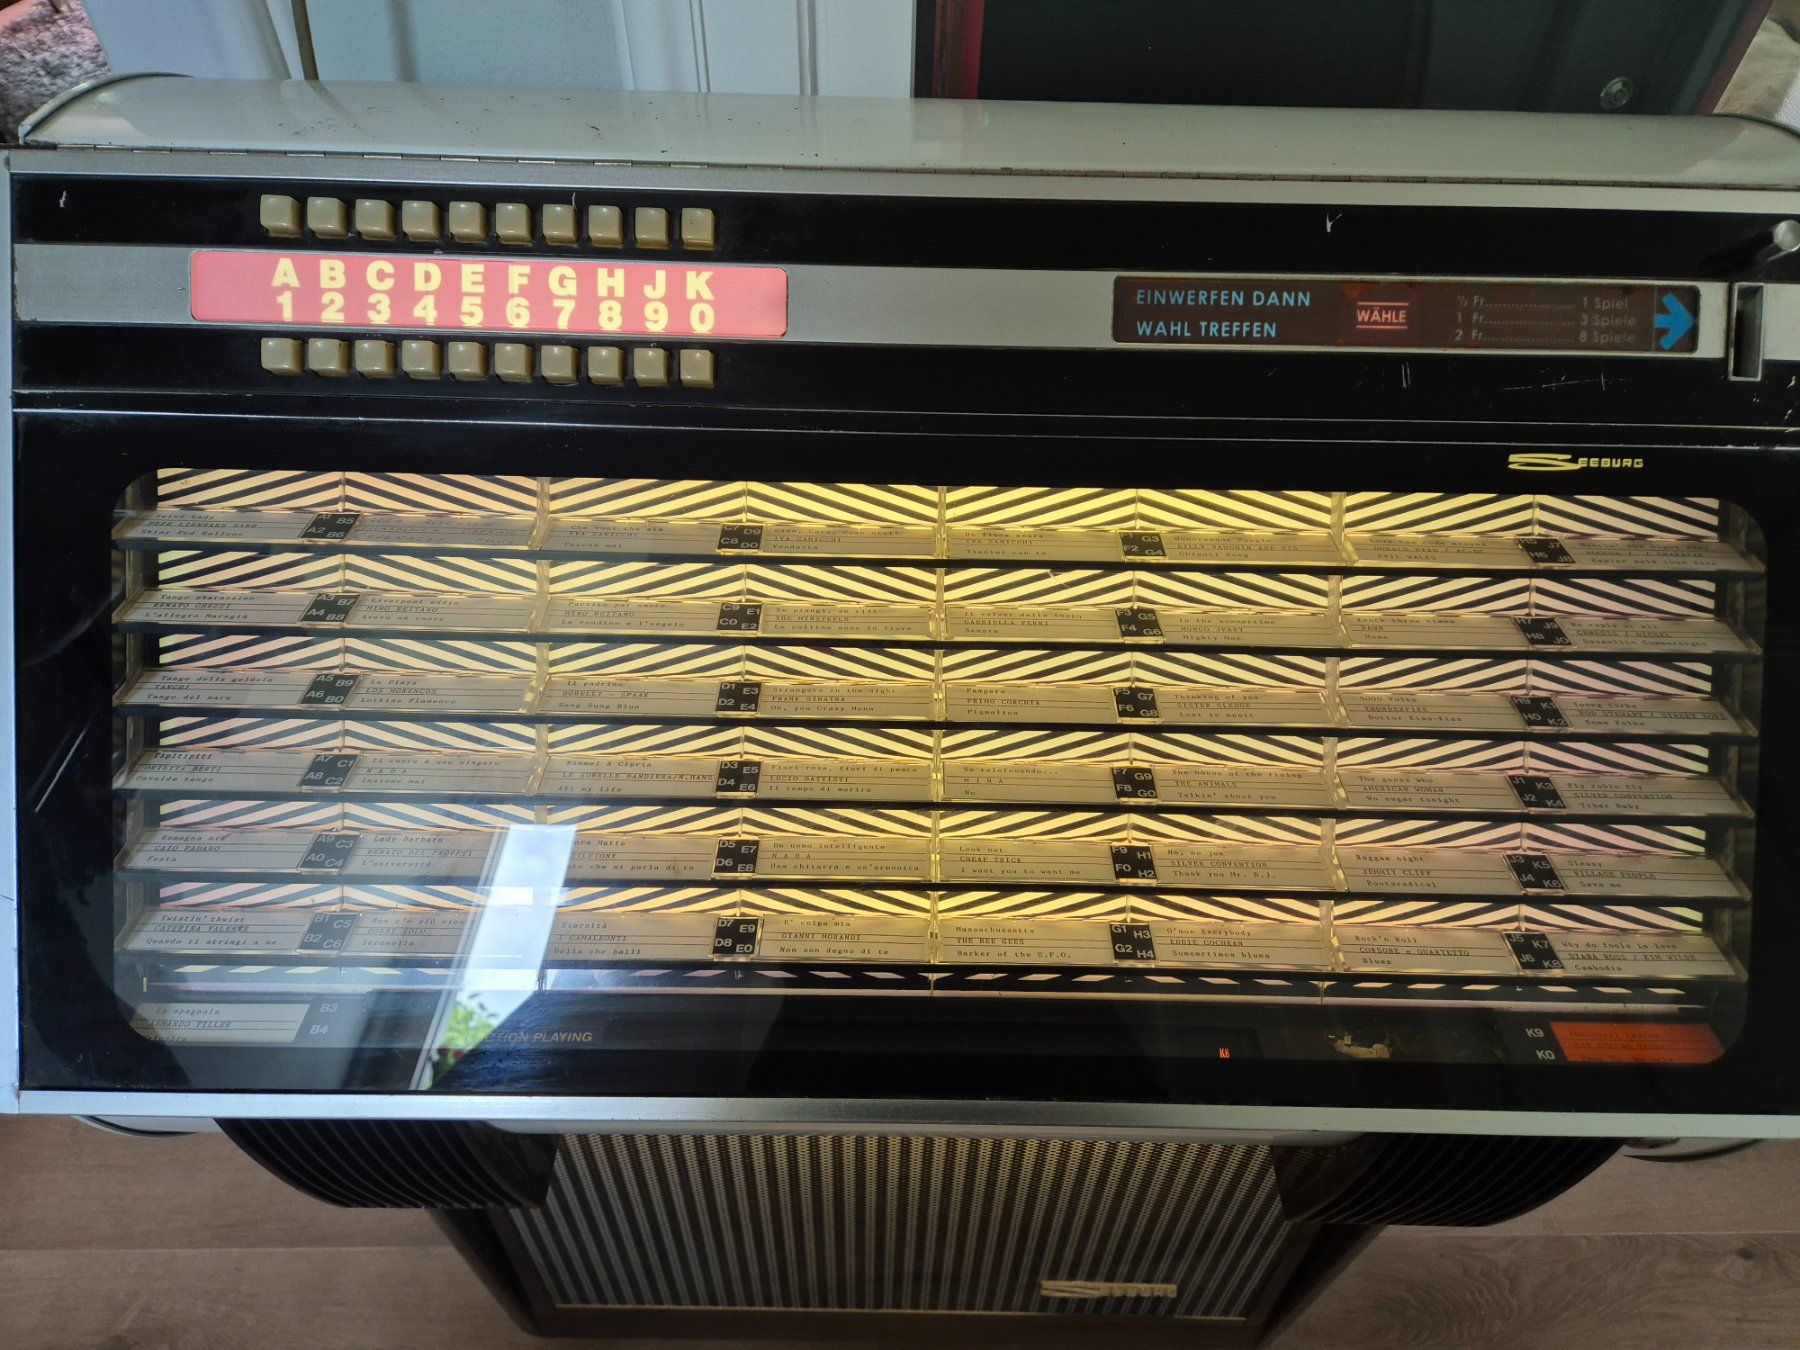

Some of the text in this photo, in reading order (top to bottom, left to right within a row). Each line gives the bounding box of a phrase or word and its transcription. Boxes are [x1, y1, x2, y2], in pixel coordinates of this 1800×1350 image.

[270, 257, 715, 300] A B C D E F G H J K
[1136, 289, 1311, 307] EINWERFEN DANN
[1582, 296, 1588, 308] 1
[1594, 297, 1628, 311] Spiel
[276, 290, 715, 333] 1 2 3 4 5 6 7 8 9 0
[1357, 307, 1407, 323] WÄHLE
[1456, 313, 1462, 324] 1
[1580, 313, 1588, 326] 3
[1593, 314, 1636, 328] Spiele
[1136, 321, 1277, 337] WAHL TREFFEN
[1456, 329, 1463, 341] 2
[1579, 331, 1588, 343] 8
[1592, 332, 1636, 344] Spiele
[1508, 453, 1644, 471] SEEBURG
[1533, 940, 1548, 948] K7
[532, 1032, 593, 1042] PLAYING
[1525, 1027, 1544, 1038] K9
